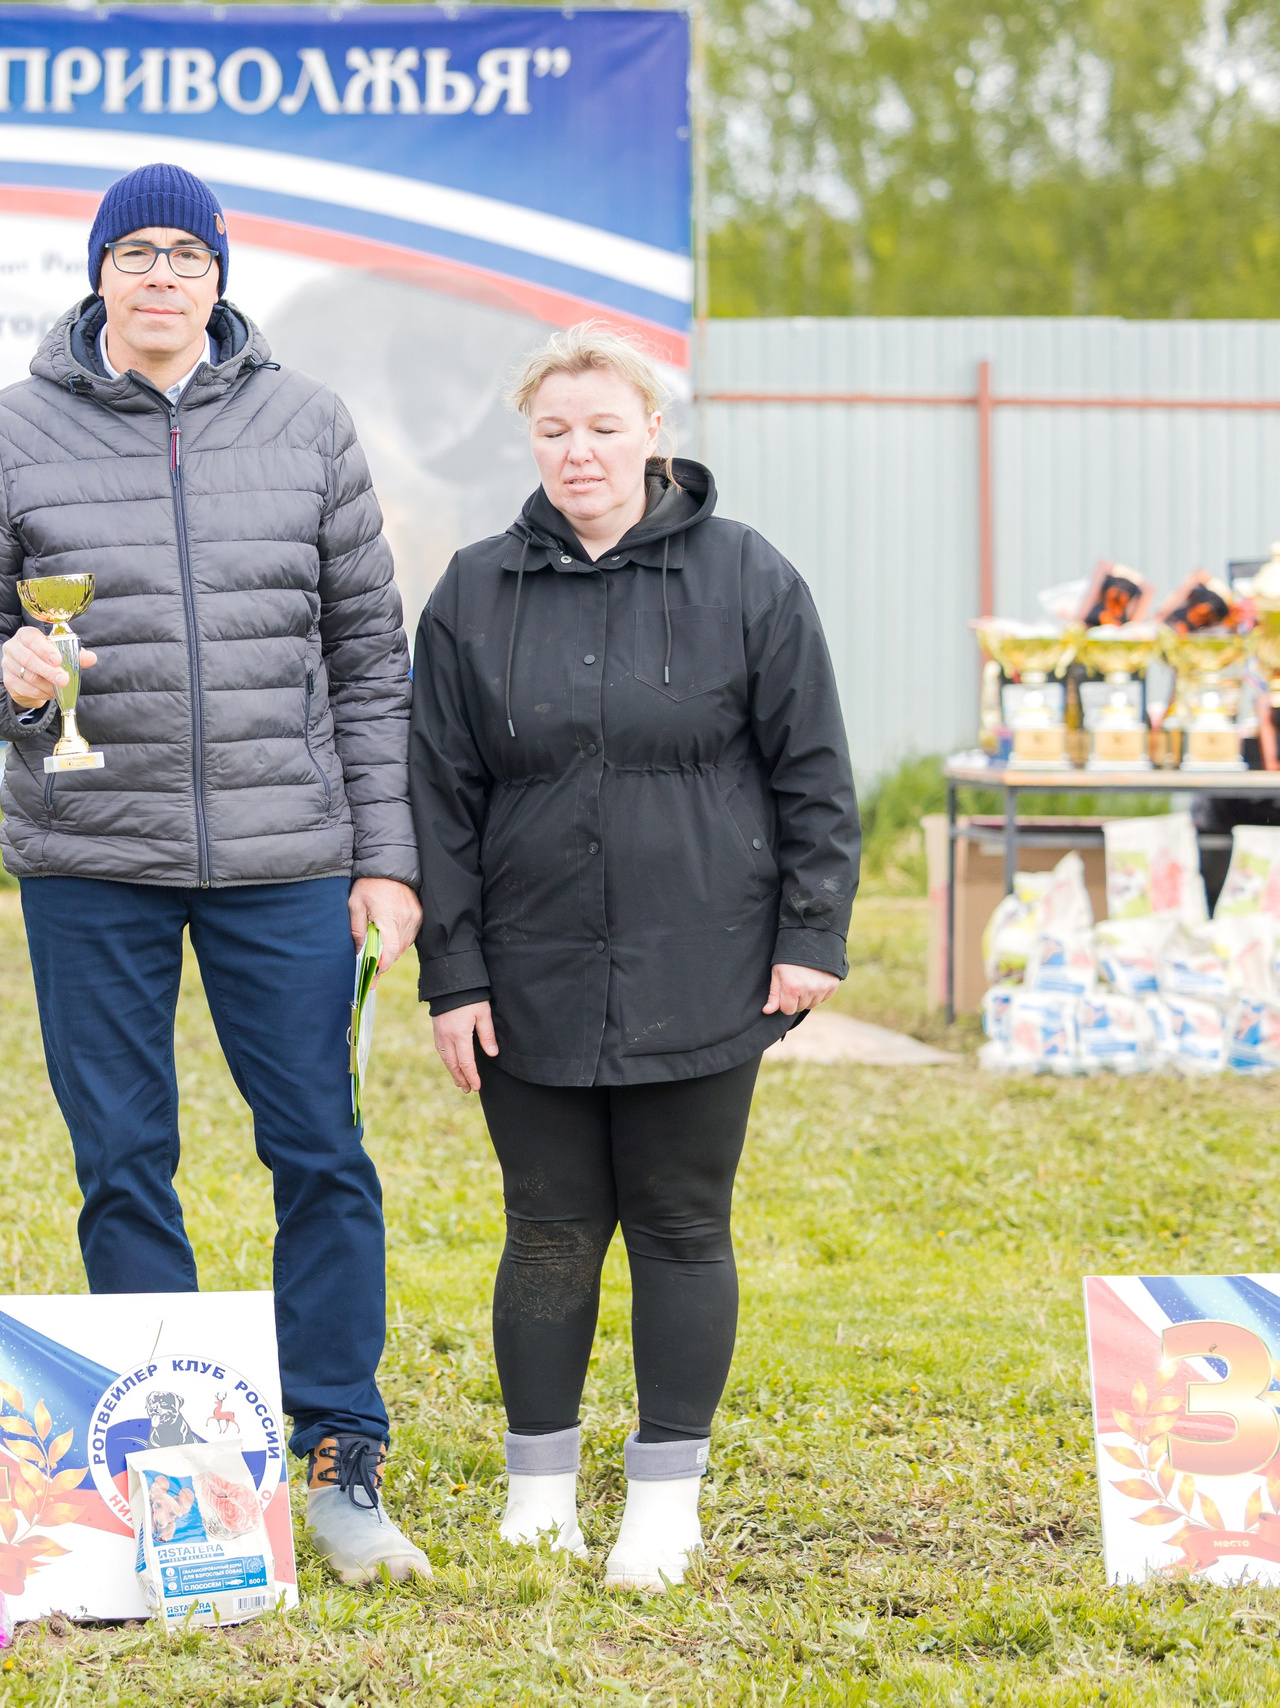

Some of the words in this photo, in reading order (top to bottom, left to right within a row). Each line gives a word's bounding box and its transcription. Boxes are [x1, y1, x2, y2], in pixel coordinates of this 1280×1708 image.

[1162, 1320, 1280, 1477] 3
[92, 1363, 159, 1466] РОТВЕЙЛЕР
[172, 1359, 226, 1380] КЛУБ
[234, 1380, 280, 1460] РОССИИ
[168, 1543, 224, 1557] STATERA
[195, 1571, 225, 1579] ВЗРОСЛЫХ
[189, 1581, 222, 1591] ЛОСОСЕМ
[173, 1602, 211, 1613] STARA
